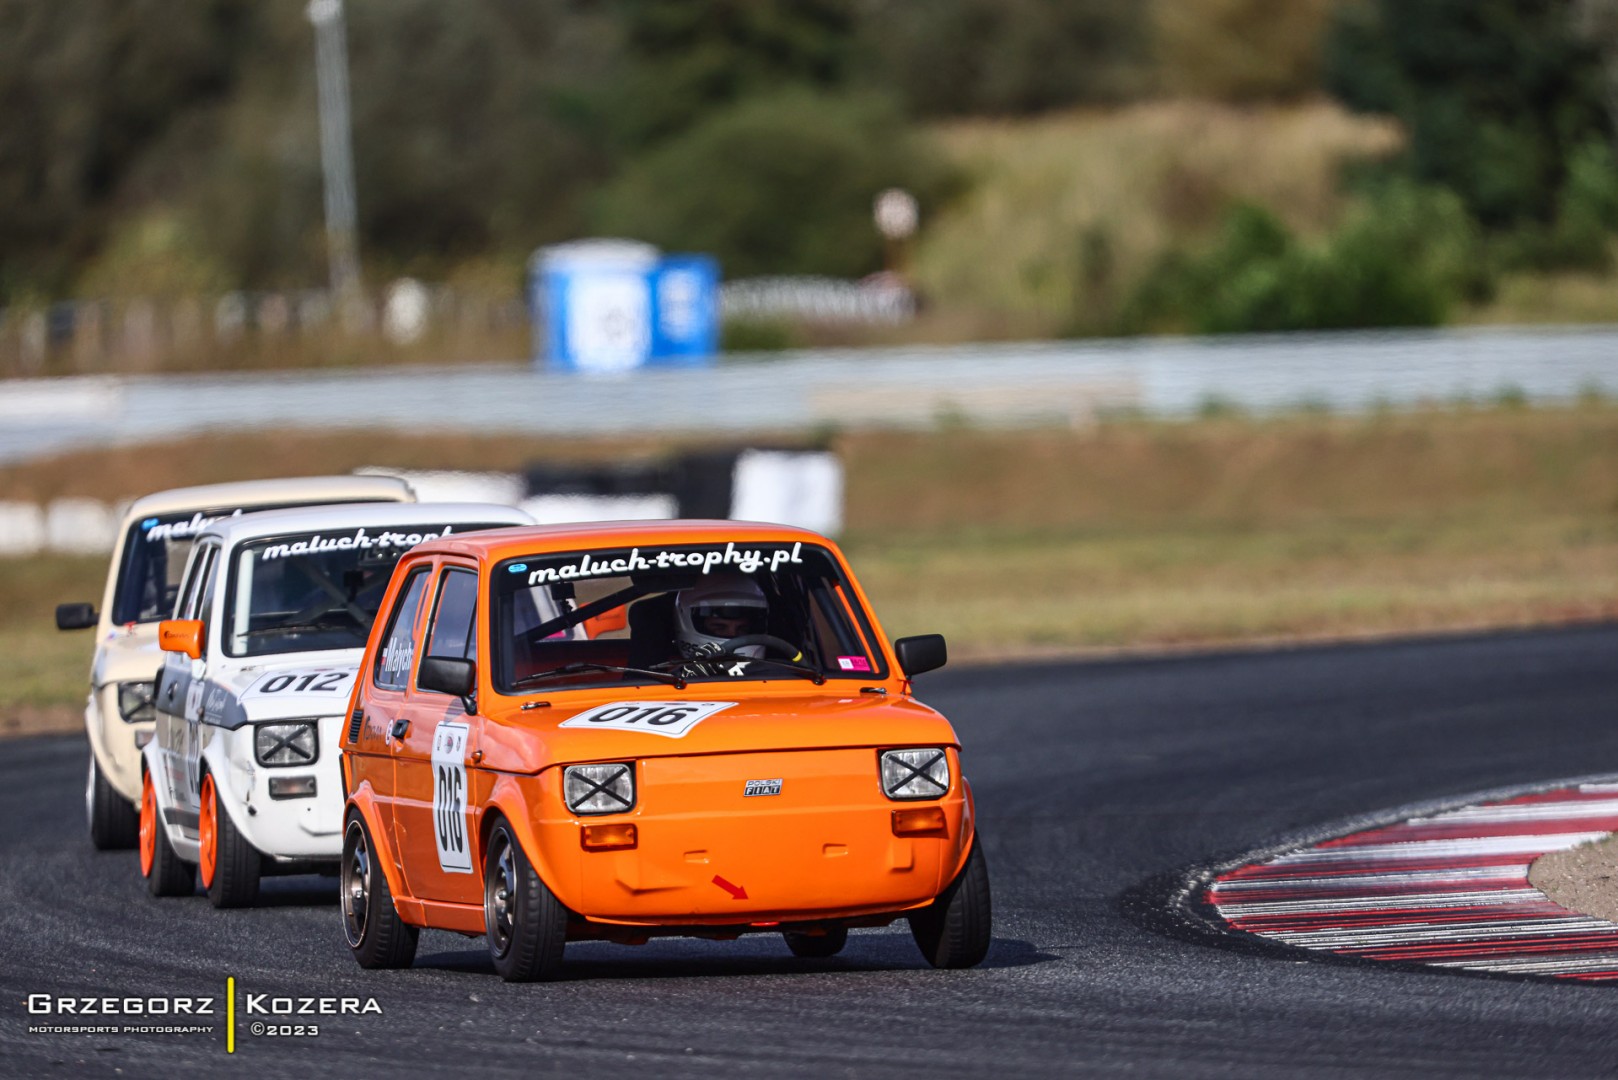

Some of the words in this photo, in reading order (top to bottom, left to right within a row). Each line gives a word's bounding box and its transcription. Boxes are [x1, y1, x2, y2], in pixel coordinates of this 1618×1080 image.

[528, 542, 802, 584] maluch-trophy.pl
[259, 672, 349, 693] 012
[588, 706, 698, 725] 016
[745, 785, 780, 795] FIAT
[438, 765, 463, 853] 016
